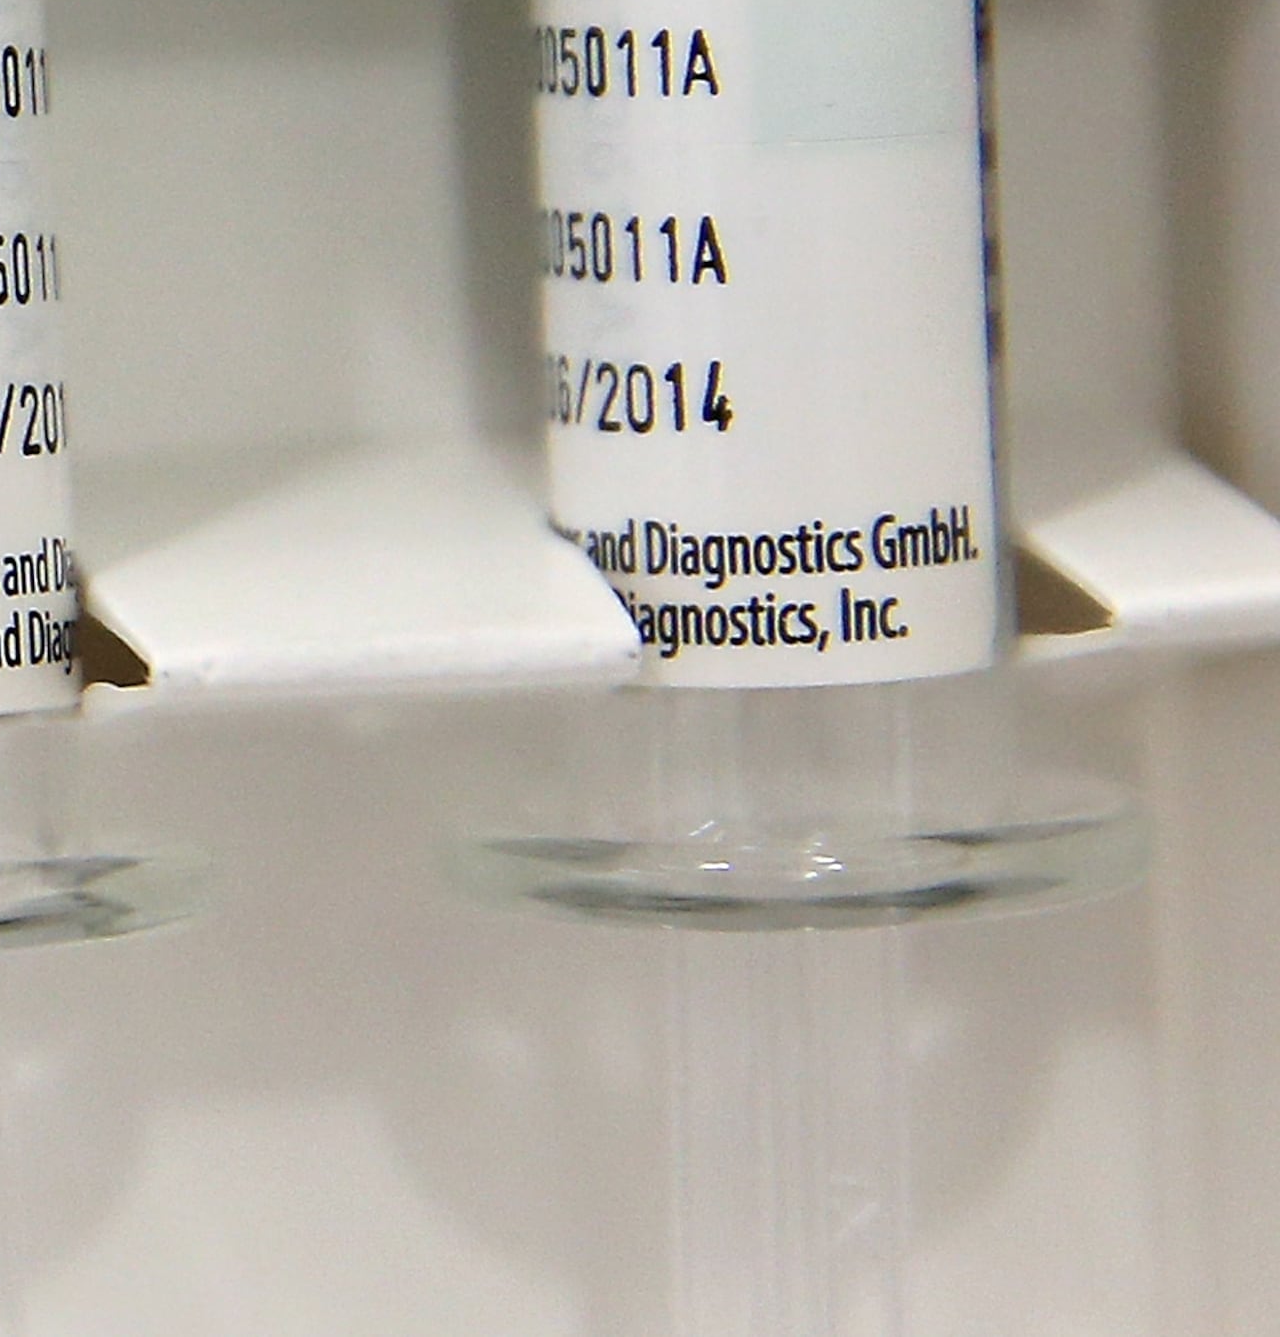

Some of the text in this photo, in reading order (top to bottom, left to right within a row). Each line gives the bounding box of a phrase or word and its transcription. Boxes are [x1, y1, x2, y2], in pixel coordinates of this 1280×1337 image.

[2, 539, 48, 596] and
[587, 506, 978, 591] and Diagnostics GmbH.
[840, 588, 908, 641] Inc.
